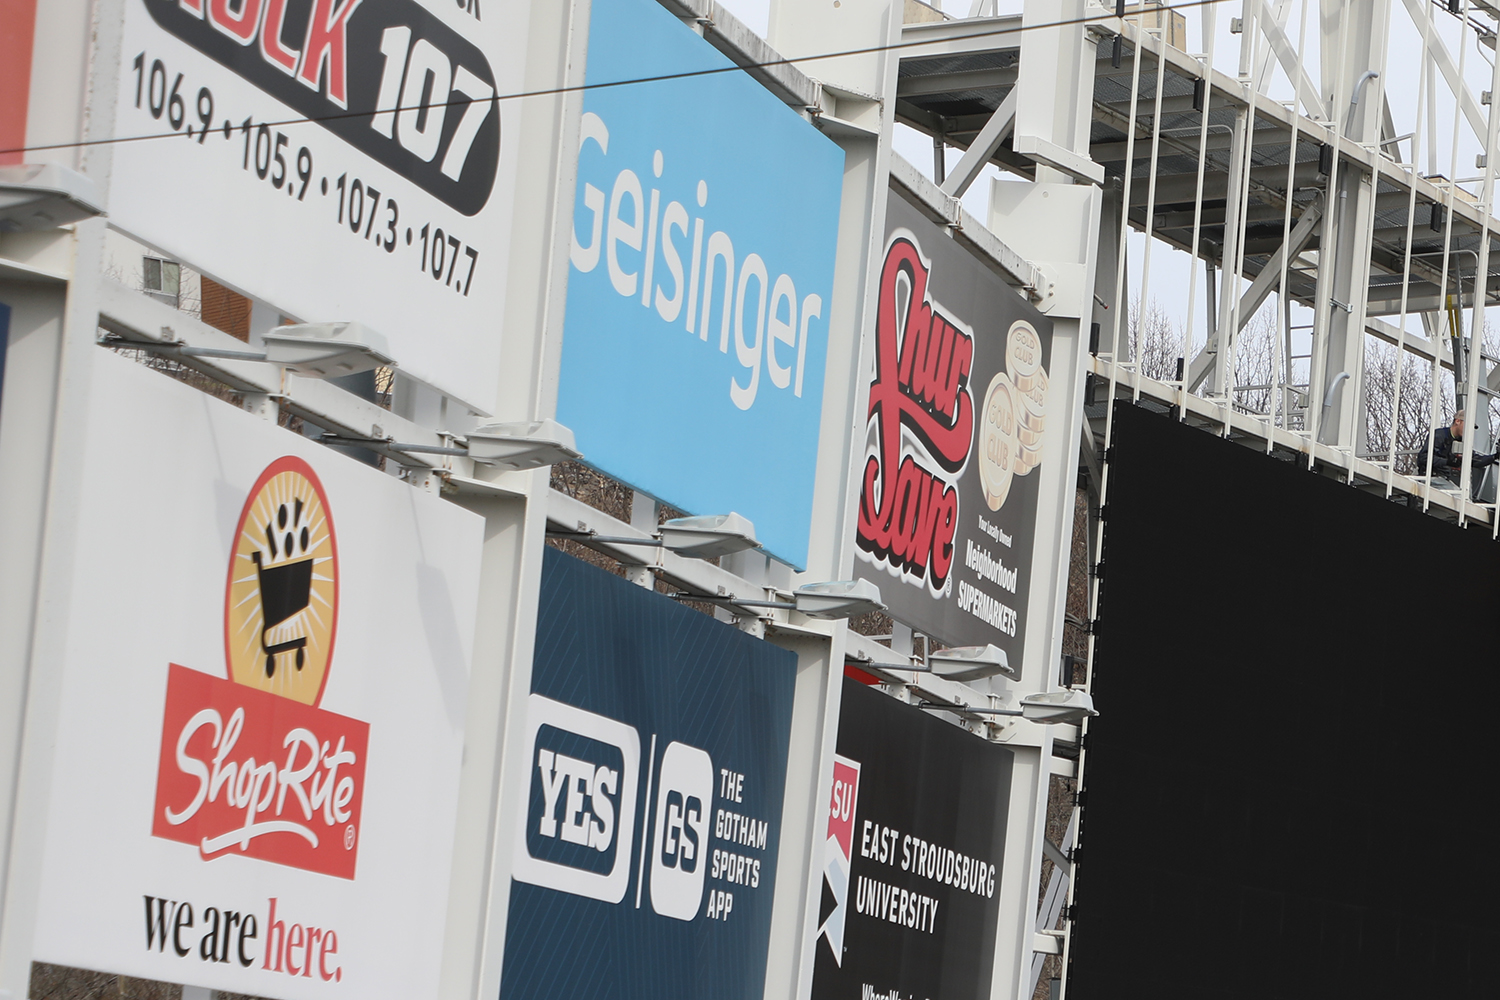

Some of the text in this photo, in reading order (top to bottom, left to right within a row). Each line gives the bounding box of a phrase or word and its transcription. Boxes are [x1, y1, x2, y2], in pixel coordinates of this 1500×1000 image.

[371, 26, 494, 182] 107
[133, 51, 479, 297] 106.9 105.9 107.3 107.7
[569, 112, 821, 410] Geisinger
[869, 237, 973, 464] Shur
[1014, 346, 1034, 366] CLUB
[1015, 332, 1035, 350] GOLD
[989, 404, 1012, 437] GOLD
[986, 433, 1009, 471] CLUB
[857, 452, 957, 590] Save
[965, 539, 1017, 594] Neighborhood
[957, 580, 1017, 637] SUPERMARKETS
[165, 706, 357, 852] ShopRite
[538, 748, 618, 853] YES
[720, 768, 745, 804] THE
[828, 777, 853, 823] SU
[661, 789, 703, 875] GS
[715, 808, 769, 851] GOTHAM
[711, 849, 761, 889] SPORTS
[861, 819, 996, 900] EAST STROUDSBURG
[706, 889, 734, 922] APP
[856, 875, 939, 935] UNIVERSITY
[142, 895, 343, 983] we are here.
